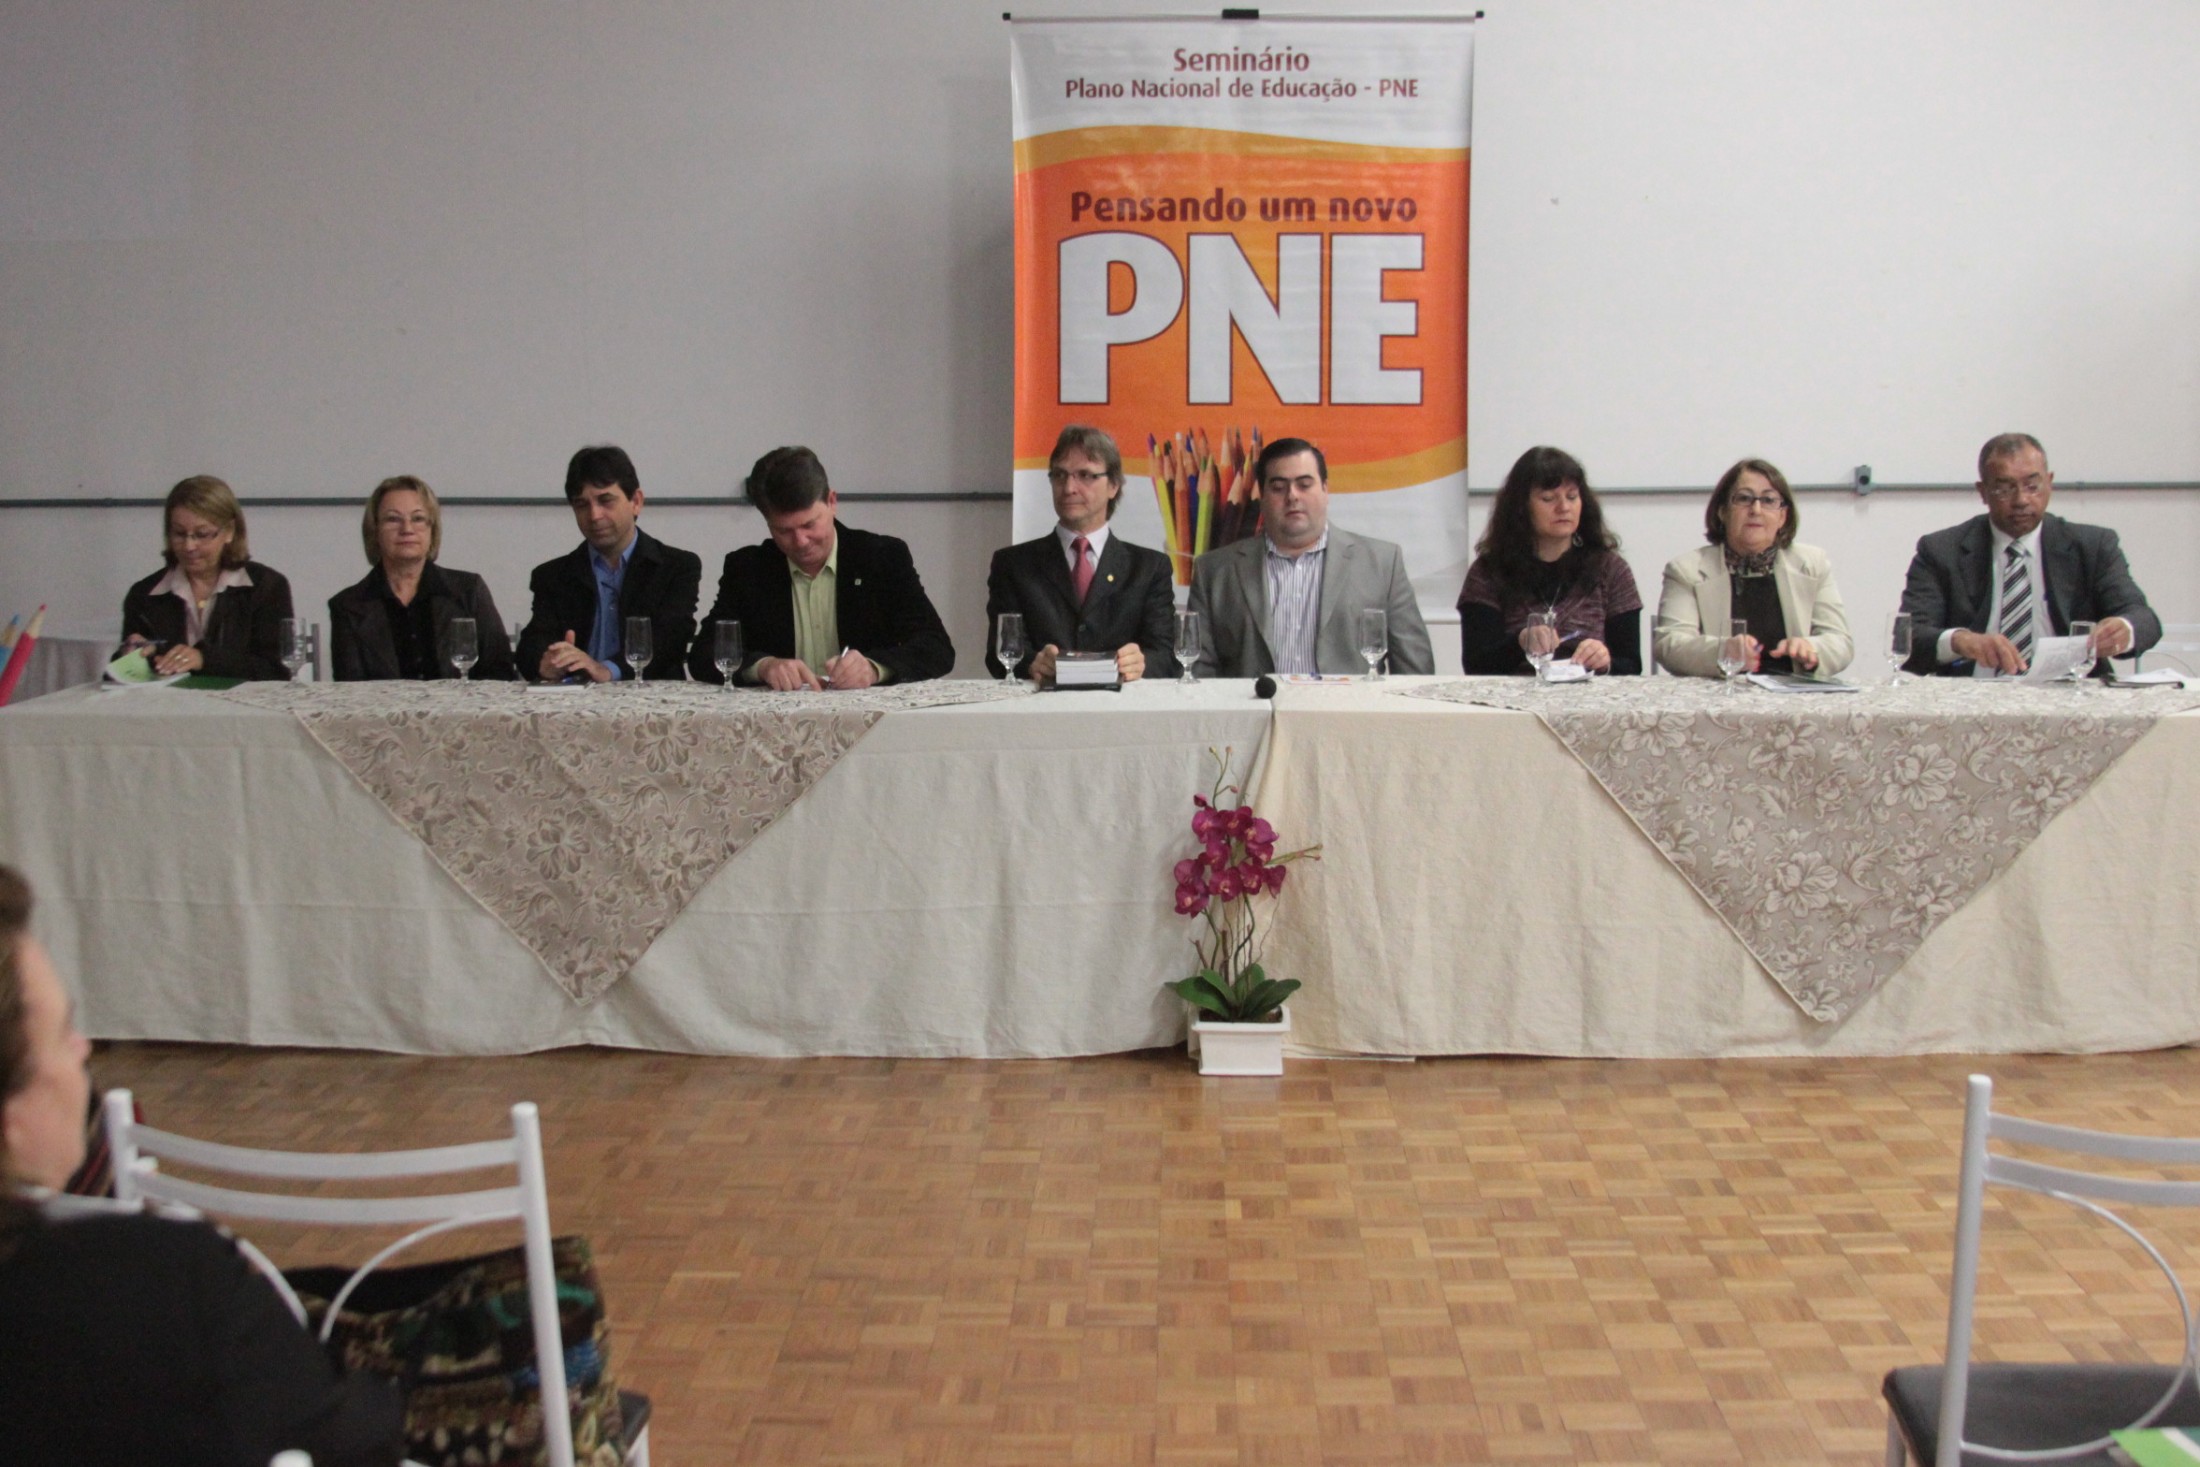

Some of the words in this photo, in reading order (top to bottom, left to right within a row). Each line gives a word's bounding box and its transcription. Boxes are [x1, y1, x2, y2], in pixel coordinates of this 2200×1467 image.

[1173, 46, 1309, 73] Seminário
[1065, 79, 1124, 98] Plano
[1131, 78, 1221, 98] Nacional
[1228, 78, 1253, 98] de
[1261, 78, 1357, 102] Educação
[1379, 78, 1419, 98] PNE
[1070, 187, 1247, 222] Pensando
[1260, 197, 1316, 222] um
[1329, 196, 1418, 222] novo
[1057, 230, 1425, 406] PNE
